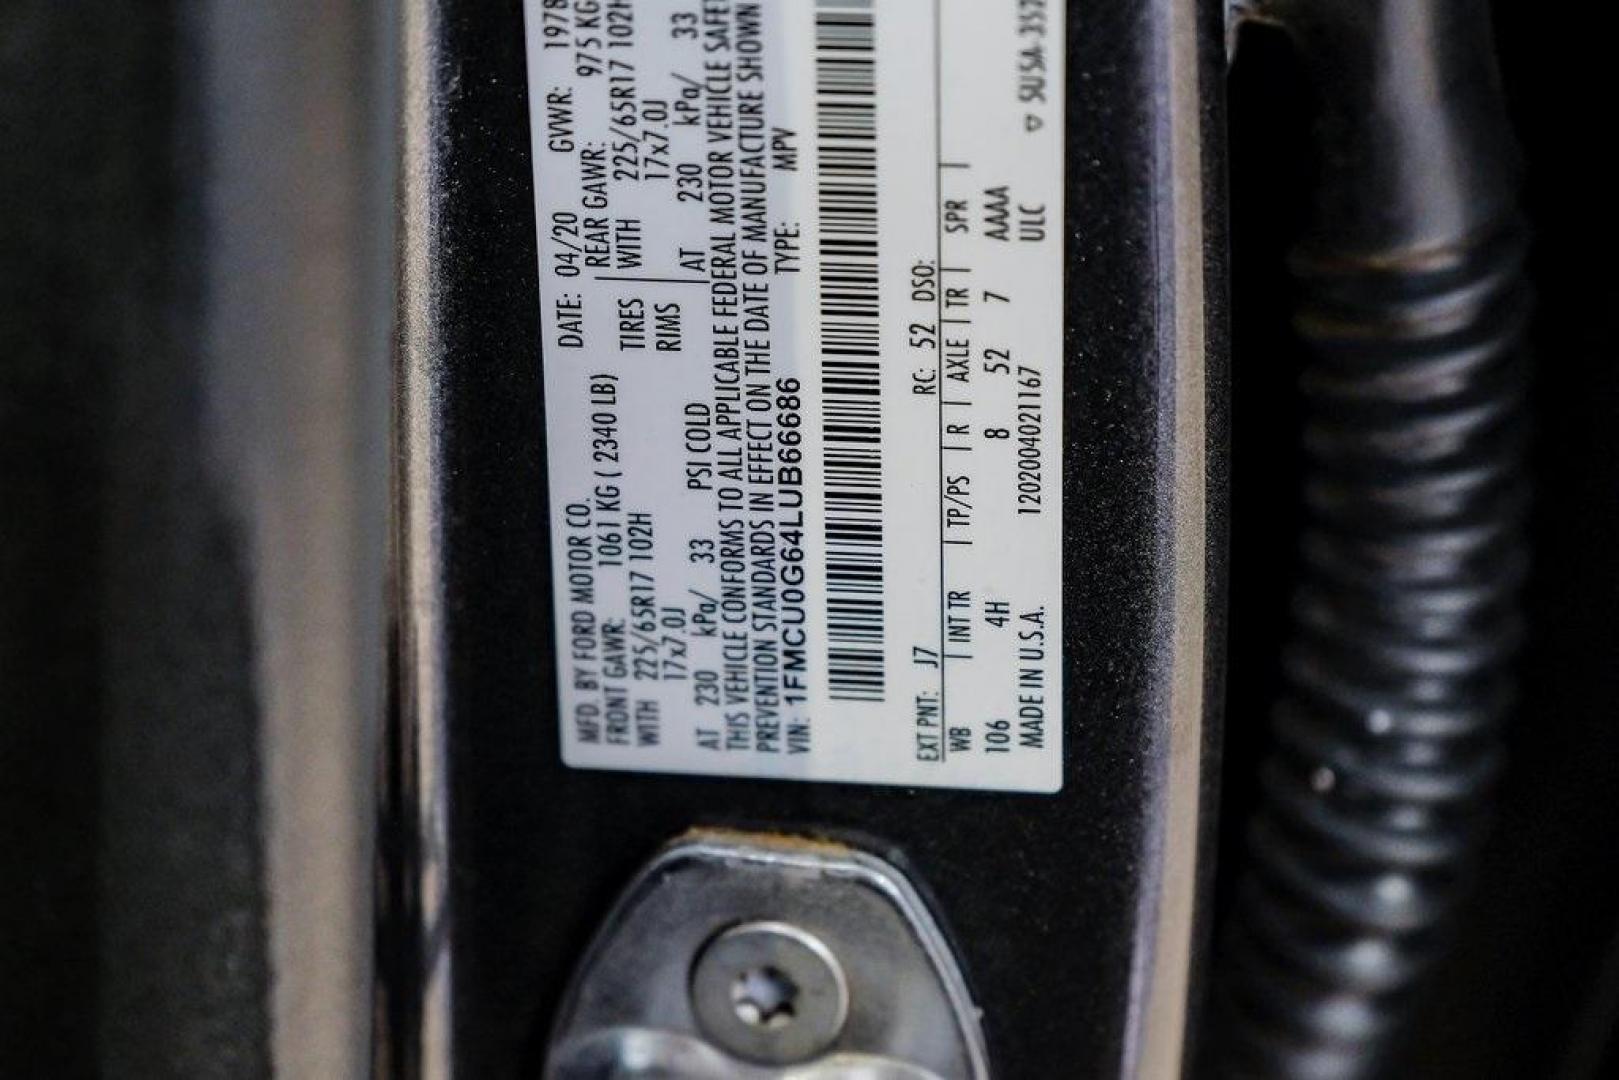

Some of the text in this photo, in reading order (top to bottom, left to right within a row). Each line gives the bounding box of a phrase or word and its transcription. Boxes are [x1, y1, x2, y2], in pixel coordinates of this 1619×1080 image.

[546, 87, 574, 152] GVWR:
[574, 0, 610, 267] REAR GAWR: 975 KG
[609, 59, 641, 181] 225/65R17
[641, 99, 670, 180] 17x7.0J
[670, 11, 705, 272] AT 230 kPa/ 33
[703, 61, 732, 143] VEHICLE
[707, 151, 735, 224] MOTOR
[771, 127, 800, 275] TYPE: MPV
[551, 212, 583, 348] DATE: 04/20
[615, 219, 641, 269] WITH
[709, 233, 737, 317] FEDERAL
[618, 298, 645, 352] TIRES
[654, 303, 681, 351] RIMS
[909, 259, 937, 395] RC: 52 DSO:
[589, 374, 618, 405] LB)
[712, 324, 742, 441] APPLICABLE
[735, 2, 780, 753] PREVENTION STANDARDS IN EFFECT ON THE DATE OF MANUFACTURE SHOWN
[595, 485, 620, 511] KG
[716, 447, 743, 481] ALL
[718, 487, 743, 511] TO
[943, 199, 973, 752] WB INT TR TP/PS R AXLE TR SPR
[983, 186, 1011, 753] 106 4H 8 52 7 AAAA
[1017, 203, 1045, 748] MADE IN U.S.A. 1202004021167 ULC
[595, 523, 623, 566] 1061
[684, 402, 721, 750] AT 230 kPa/ 33 PSI COLD
[717, 519, 747, 623] CONFORMS
[775, 377, 811, 755] VIN: 1FMCU0G64LUB66686
[565, 498, 600, 744] MFD. BY FORD MOTOR CO.
[601, 618, 627, 679] GAWR:
[627, 513, 662, 747] WITH 225/65R17 102H
[660, 607, 687, 681] 17x7.0J
[721, 631, 749, 706] VEHICLE
[912, 646, 939, 763] EXT PNT: J7
[603, 686, 629, 745] FRONT
[723, 712, 751, 752] THIS
